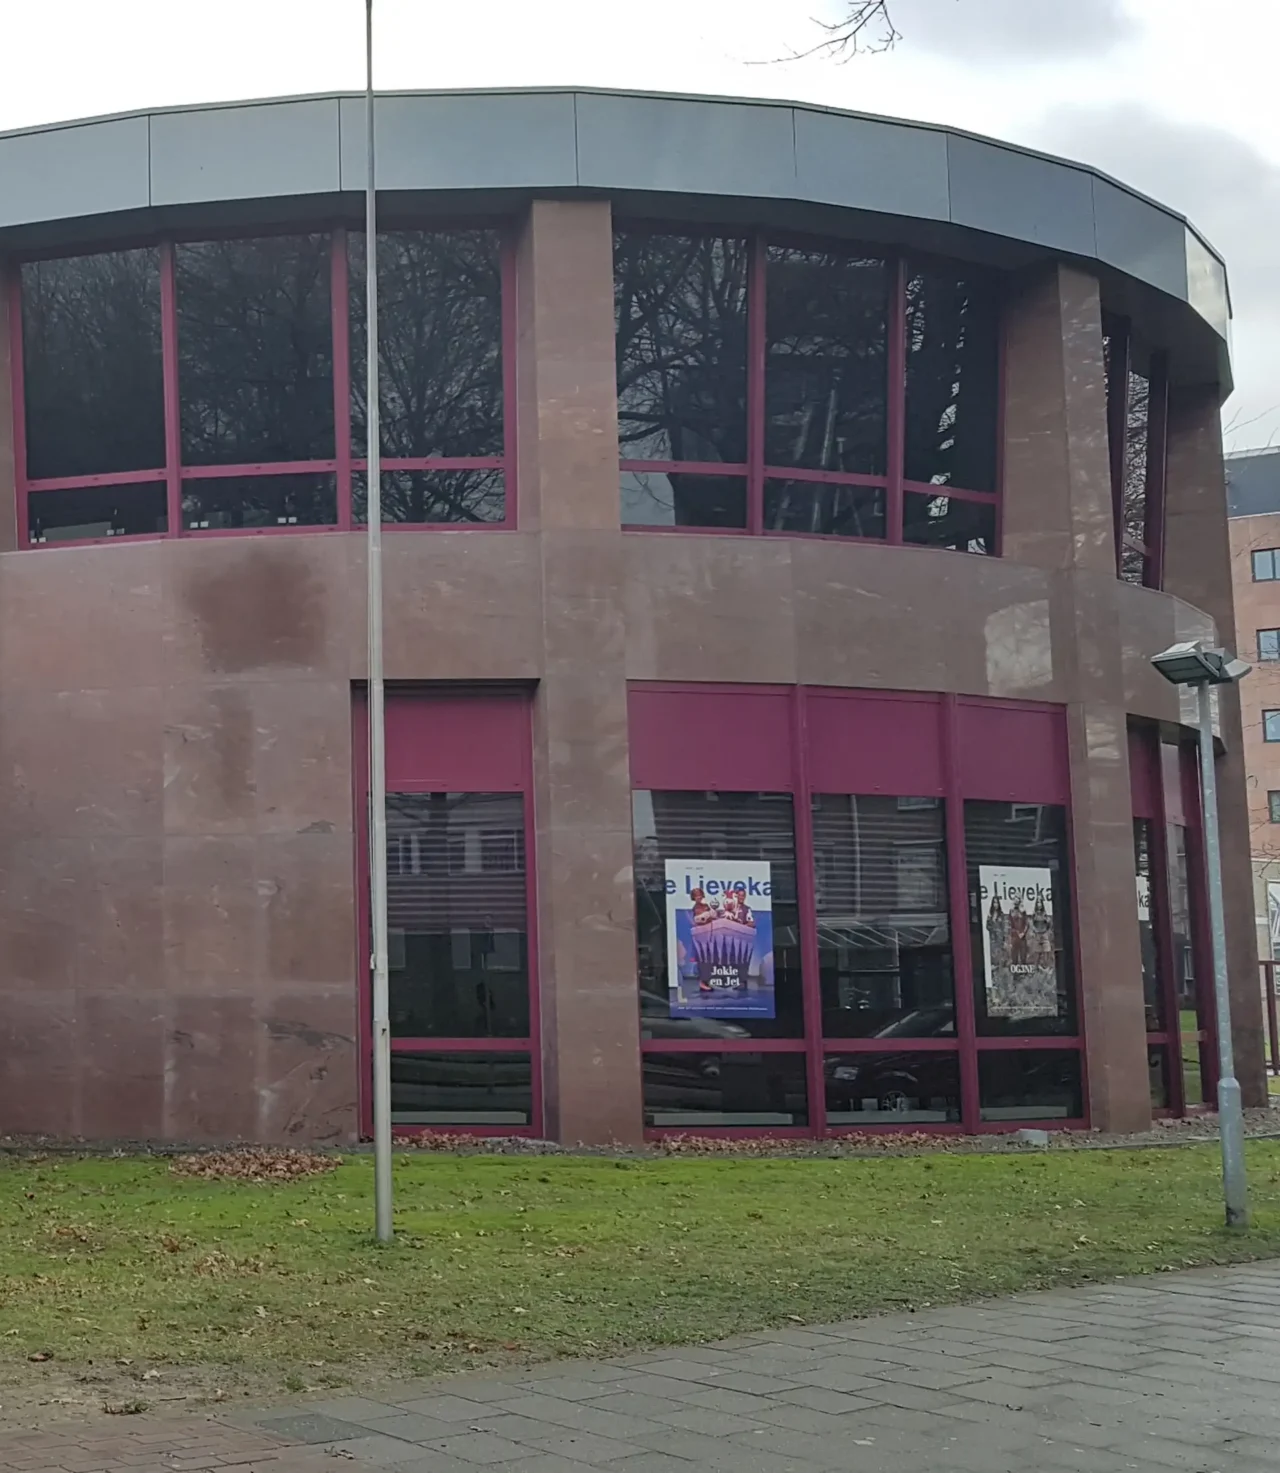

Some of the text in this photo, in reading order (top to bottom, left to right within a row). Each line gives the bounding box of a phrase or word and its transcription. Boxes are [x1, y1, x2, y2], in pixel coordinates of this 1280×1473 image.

[711, 965, 739, 976] Jokie
[710, 977, 740, 986] en Jet
